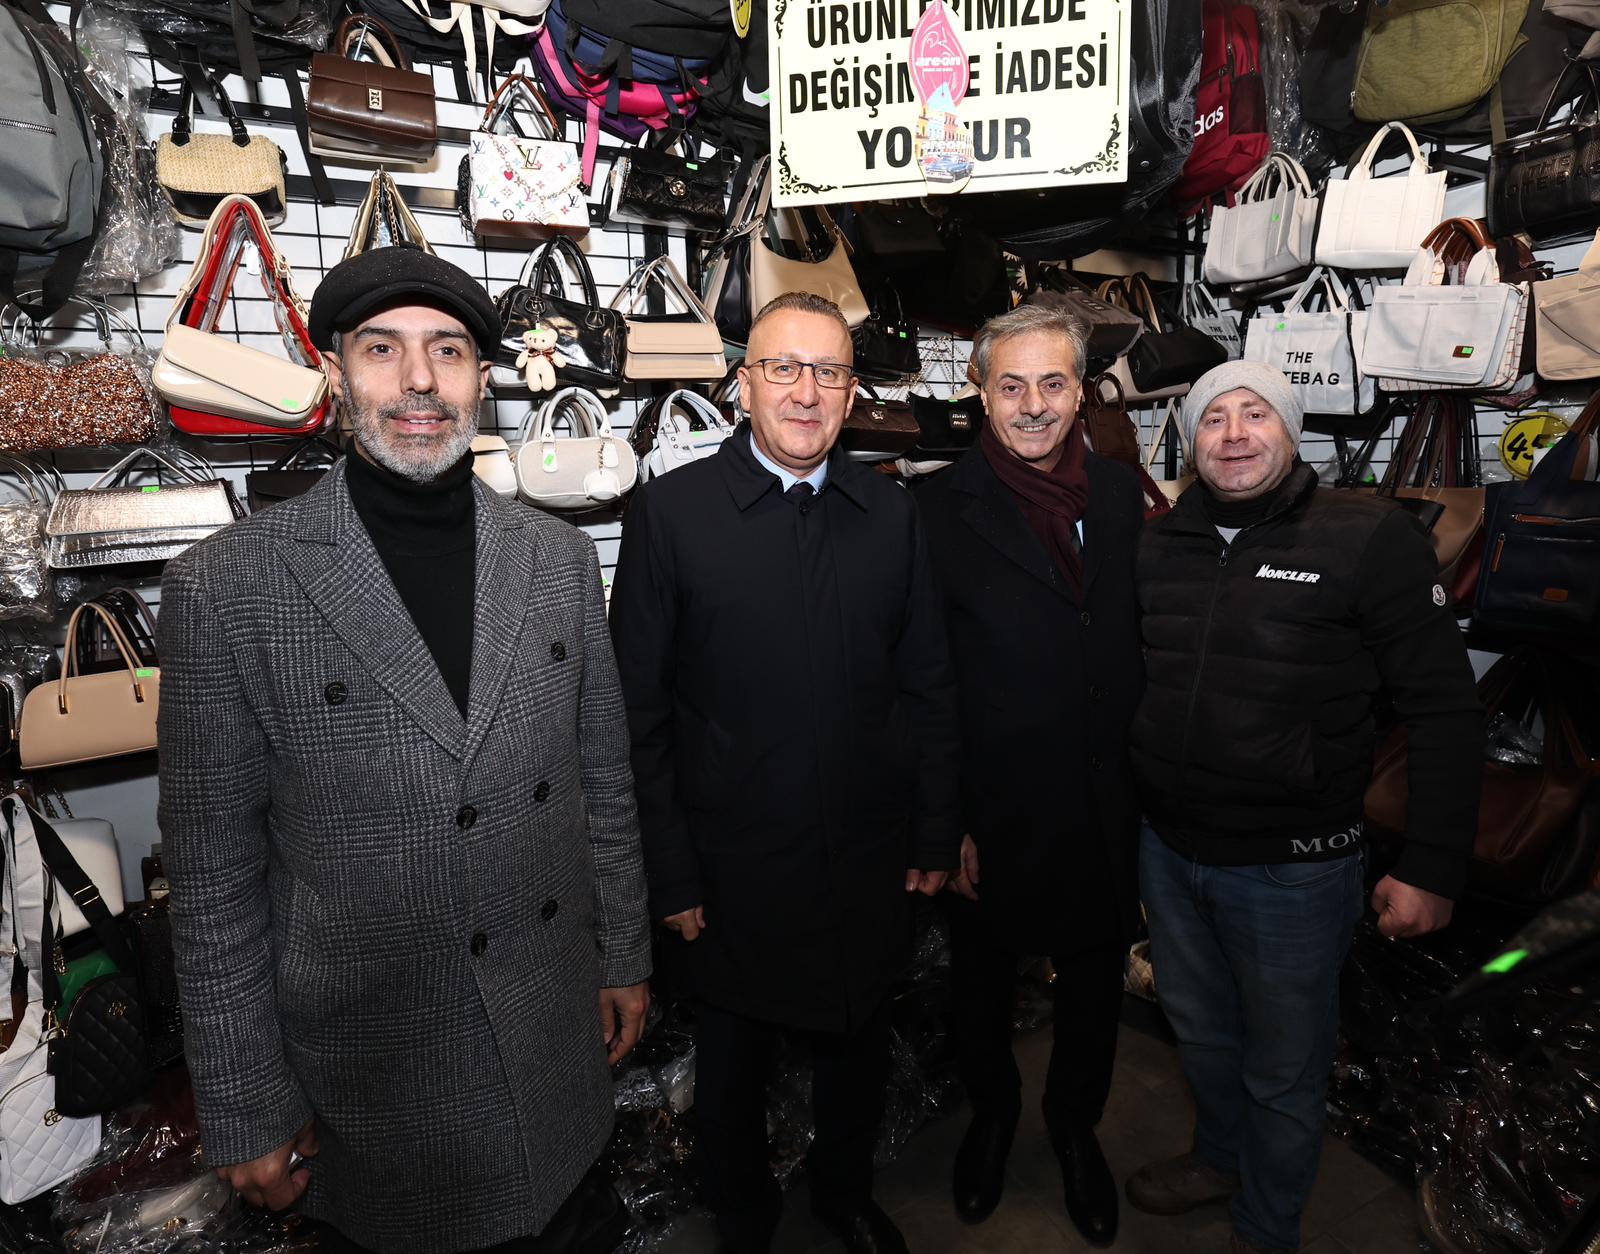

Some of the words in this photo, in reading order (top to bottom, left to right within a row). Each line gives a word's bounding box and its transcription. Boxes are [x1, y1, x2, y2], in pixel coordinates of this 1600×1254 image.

[915, 56, 961, 66] areon
[995, 32, 1107, 95] İADESİ
[1286, 352, 1314, 363] THE
[1255, 564, 1320, 583] MONCLER
